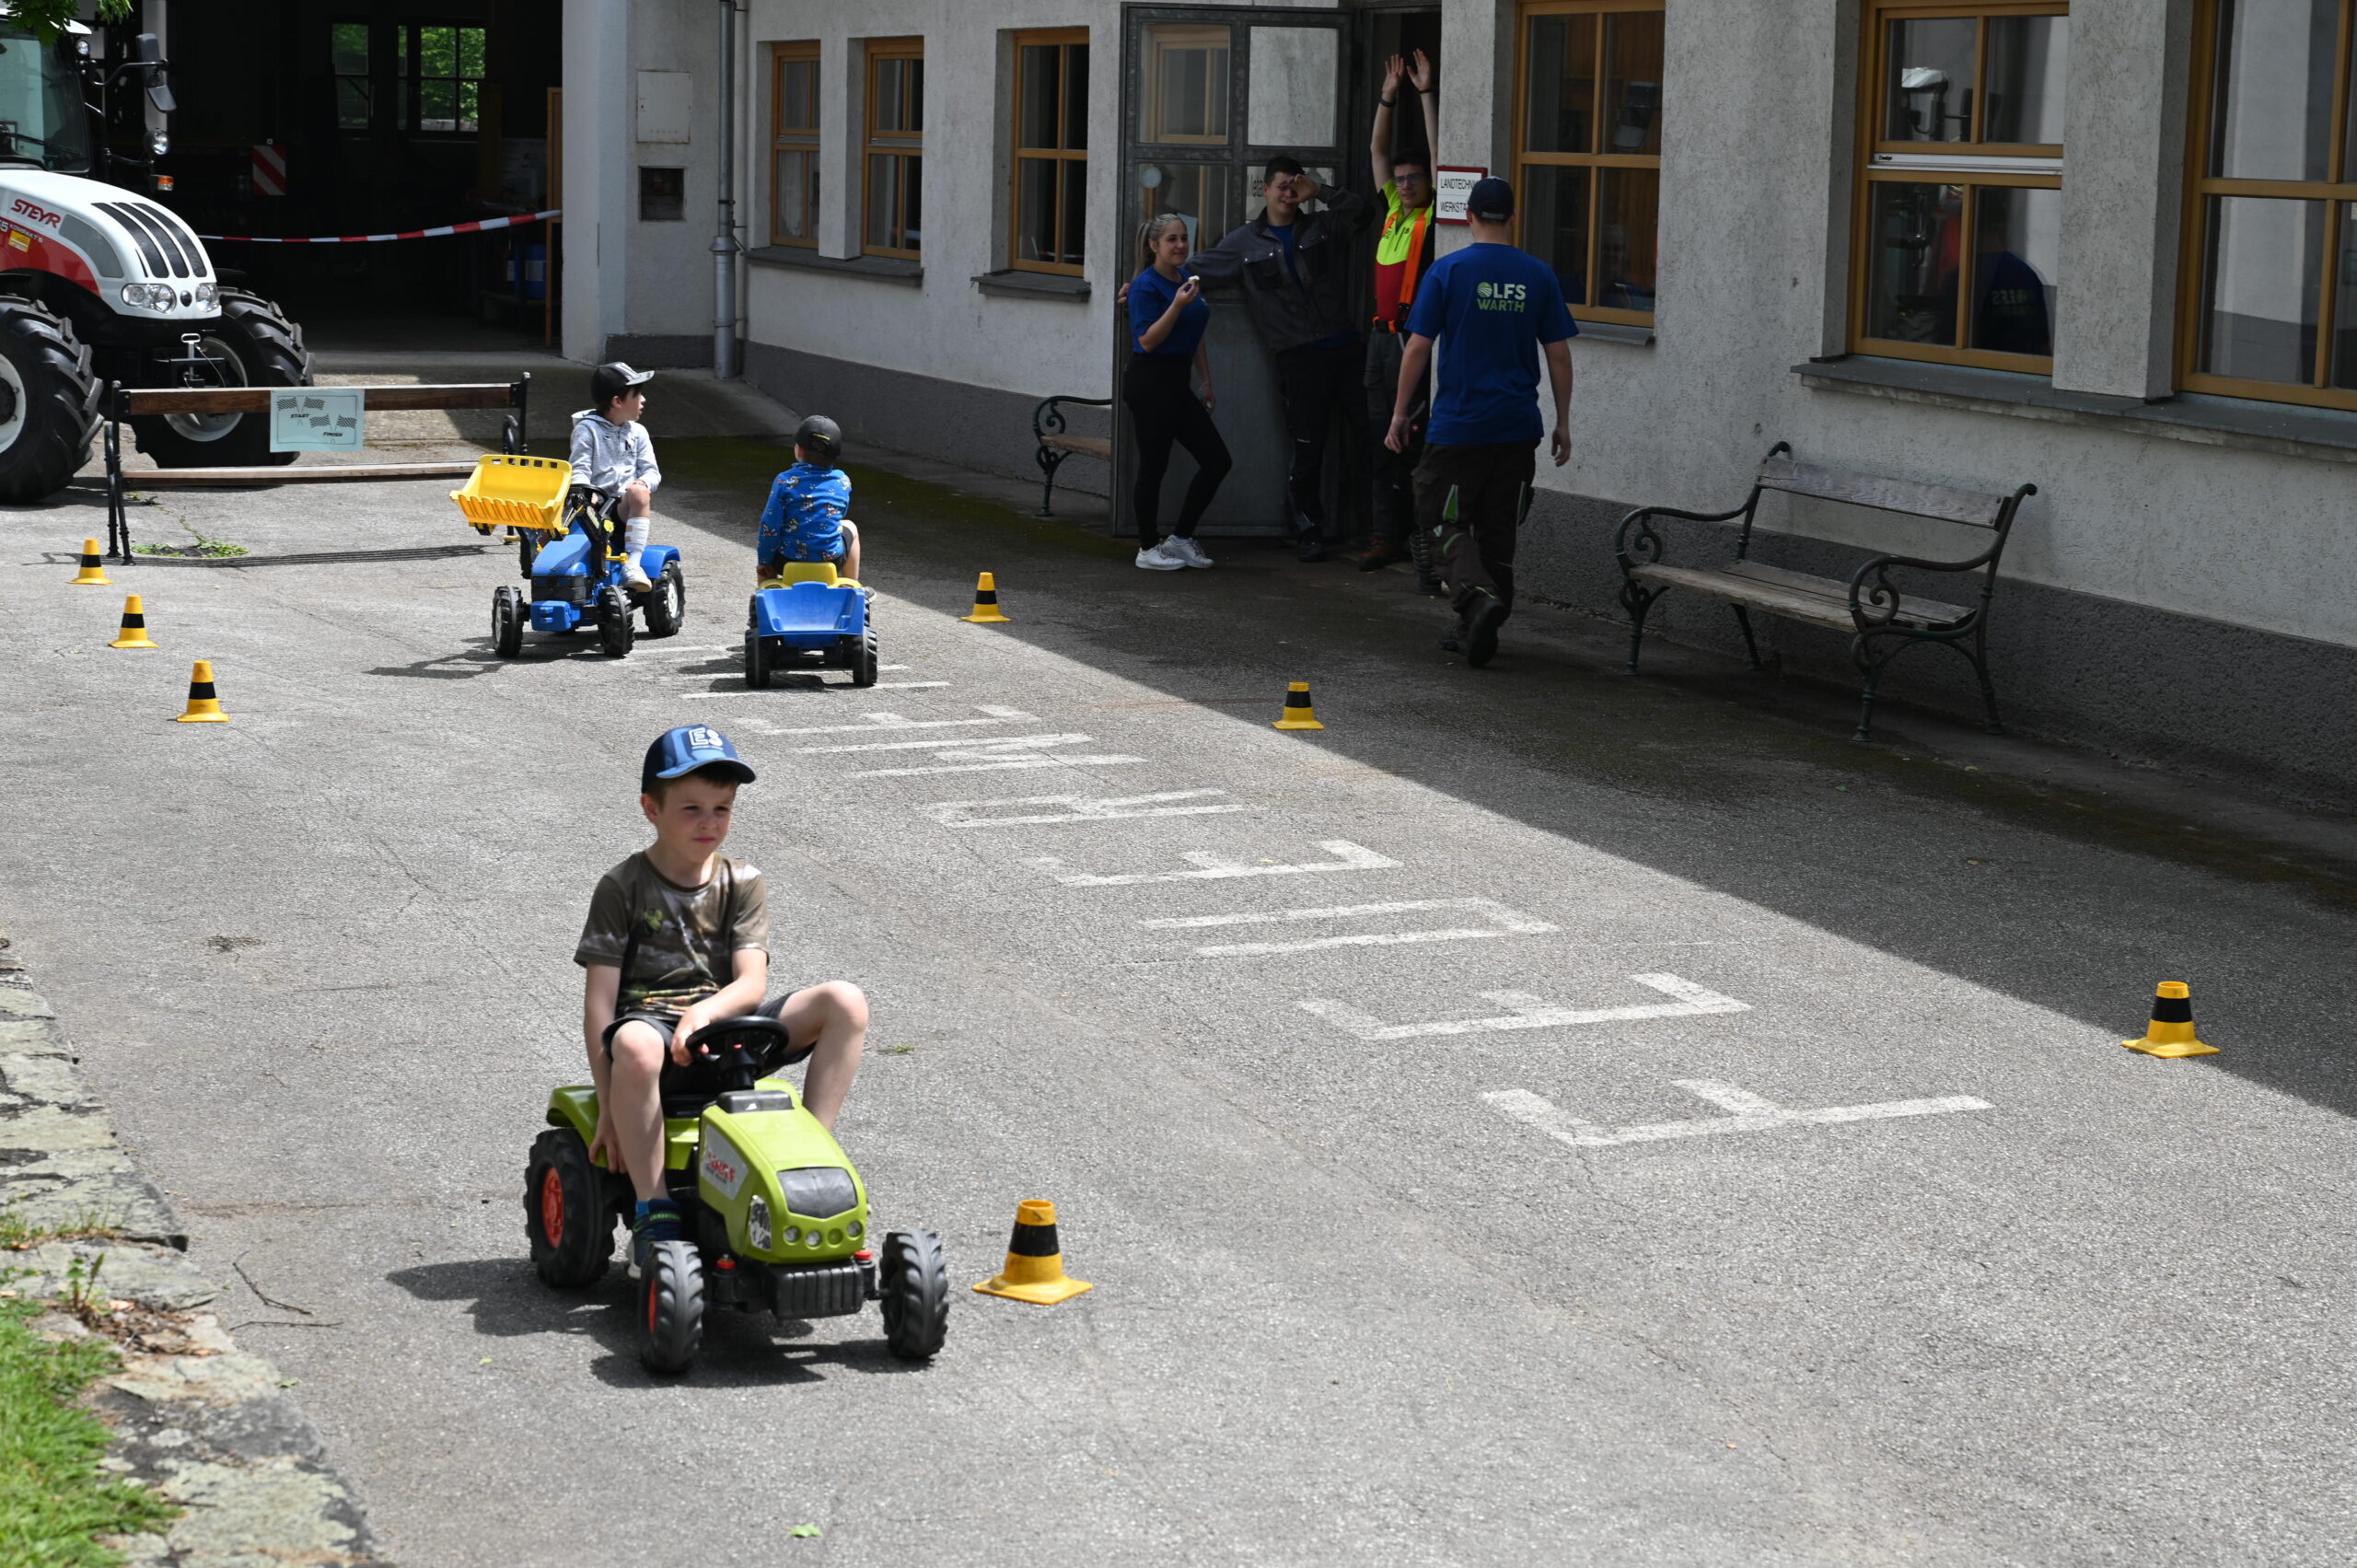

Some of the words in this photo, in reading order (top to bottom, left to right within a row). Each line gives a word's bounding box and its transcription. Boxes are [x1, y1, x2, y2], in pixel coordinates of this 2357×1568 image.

[1440, 179, 1477, 190] LANDTECHN
[10, 199, 62, 229] STEYR
[1440, 201, 1469, 213] WERKSTA
[1493, 283, 1527, 301] LFS
[1477, 298, 1526, 313] WARTH
